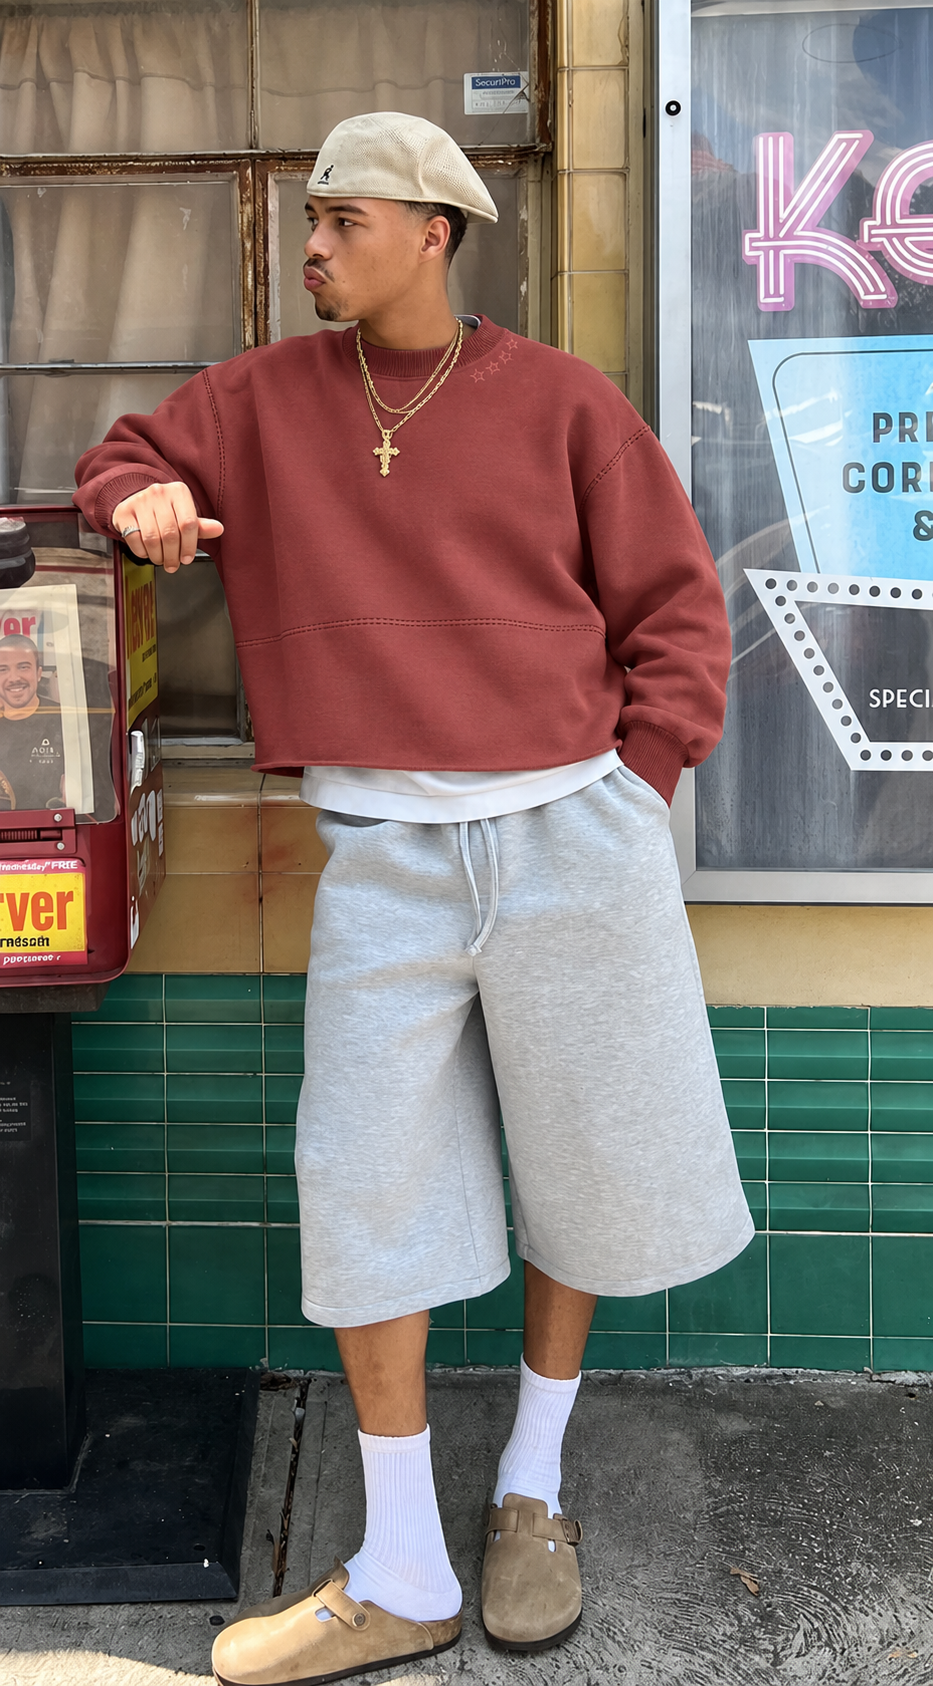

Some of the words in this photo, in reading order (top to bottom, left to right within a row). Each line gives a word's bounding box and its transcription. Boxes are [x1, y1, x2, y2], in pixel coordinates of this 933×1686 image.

[842, 461, 933, 494] COR
[869, 688, 933, 708] SPECI
[0, 890, 74, 932] ver
